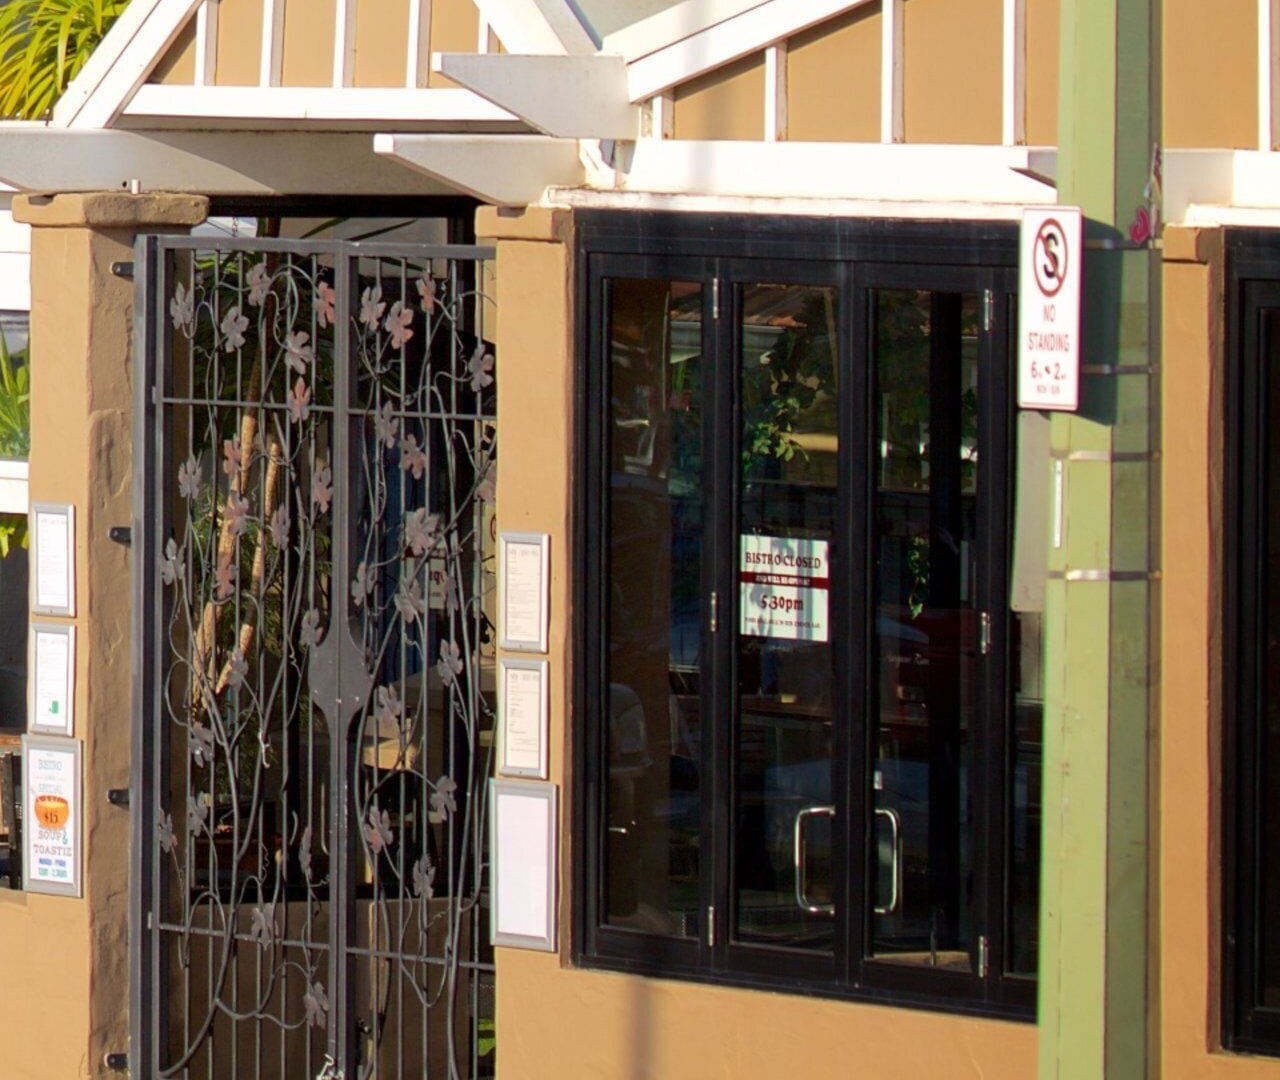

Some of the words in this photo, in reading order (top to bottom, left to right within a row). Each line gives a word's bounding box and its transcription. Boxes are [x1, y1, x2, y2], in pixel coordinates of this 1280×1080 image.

[1043, 304, 1056, 322] NO
[1028, 331, 1070, 352] STANDING
[745, 552, 782, 566] BISTRO
[783, 554, 821, 569] CLOSED
[38, 829, 62, 841] SOUP
[33, 844, 72, 856] TOASTIE
